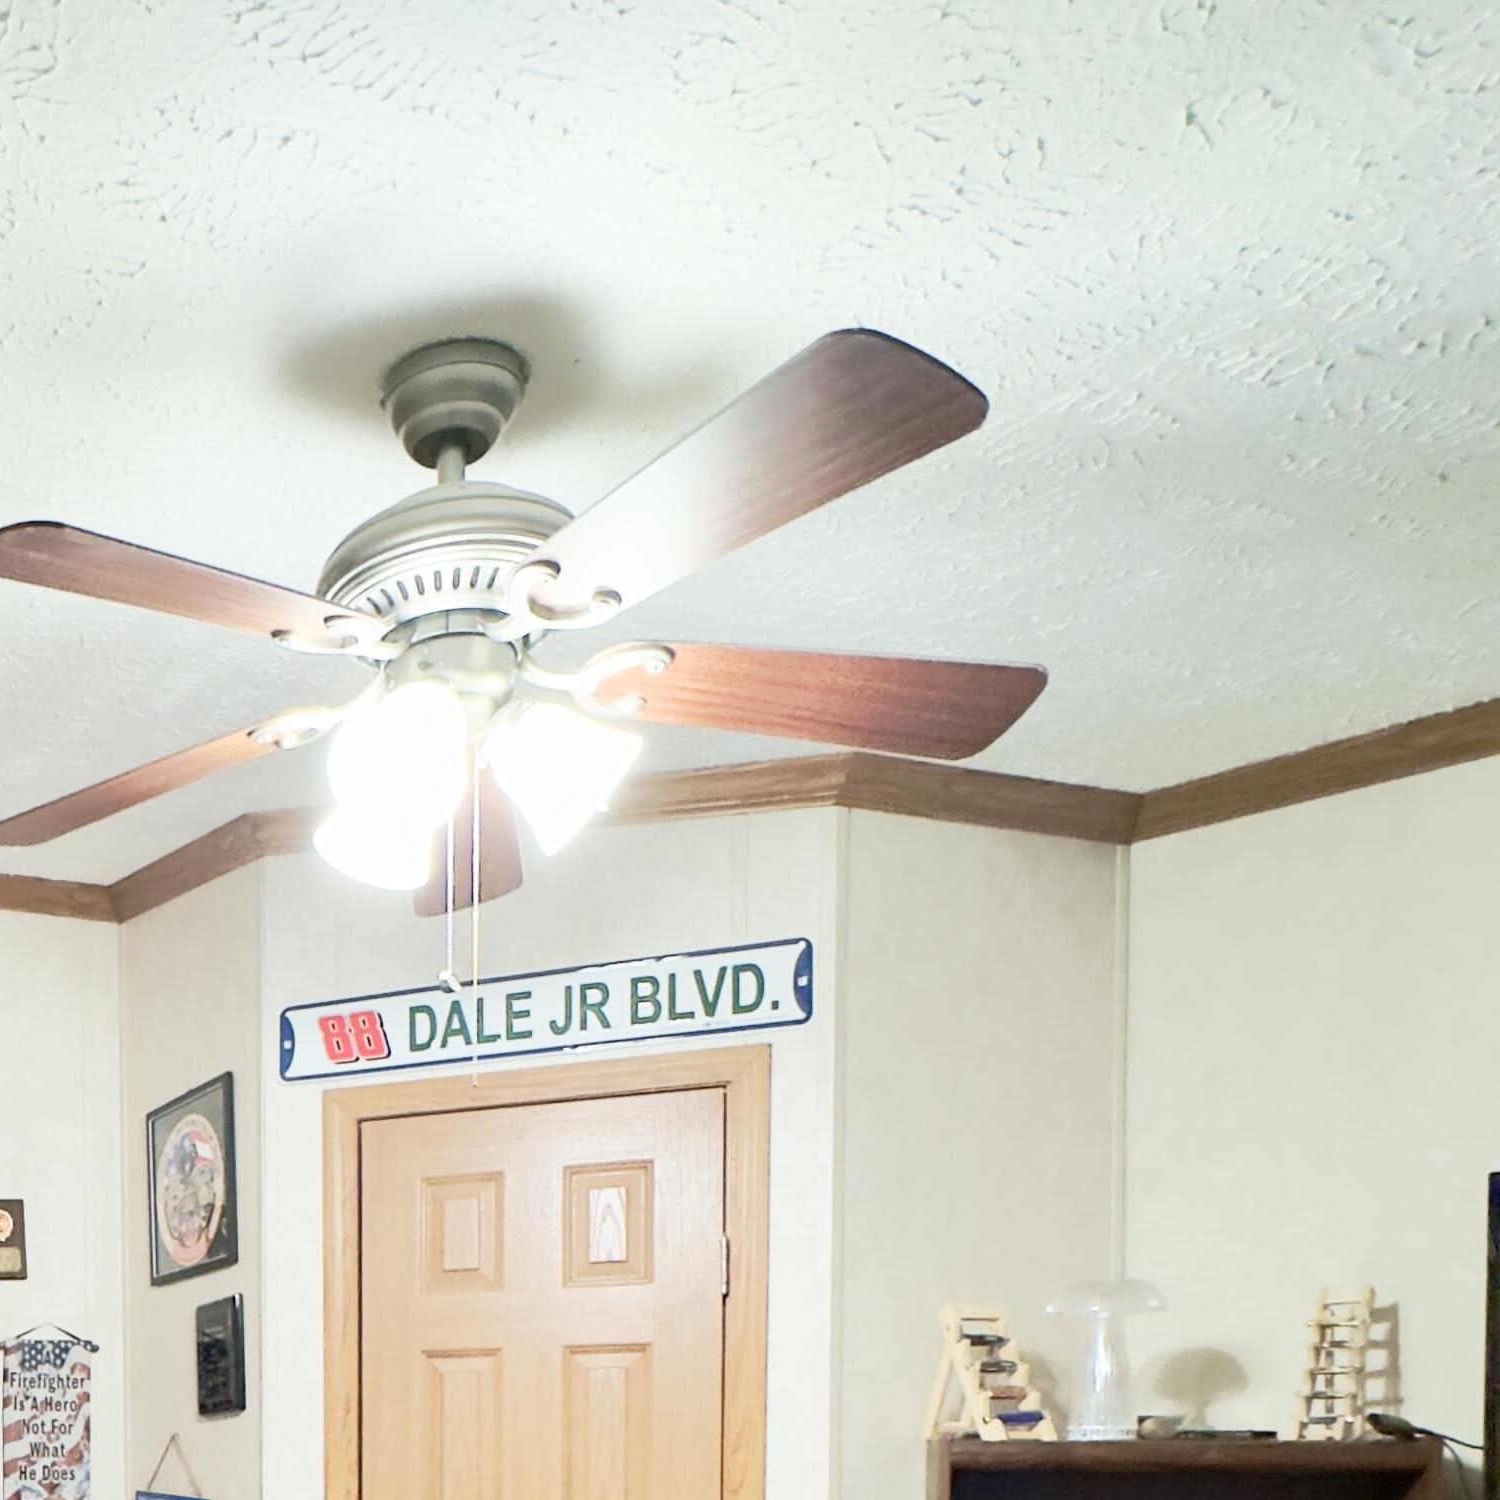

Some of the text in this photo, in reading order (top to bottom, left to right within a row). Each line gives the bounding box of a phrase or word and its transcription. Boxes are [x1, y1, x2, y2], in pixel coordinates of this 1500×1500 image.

[317, 963, 779, 1064] 88 DALE JR BLVD.
[10, 1372, 85, 1393] Firefighter
[13, 1396, 77, 1412] Is A Hero
[23, 1419, 73, 1435] Not For
[30, 1441, 65, 1458] What
[19, 1465, 76, 1481] He Does
